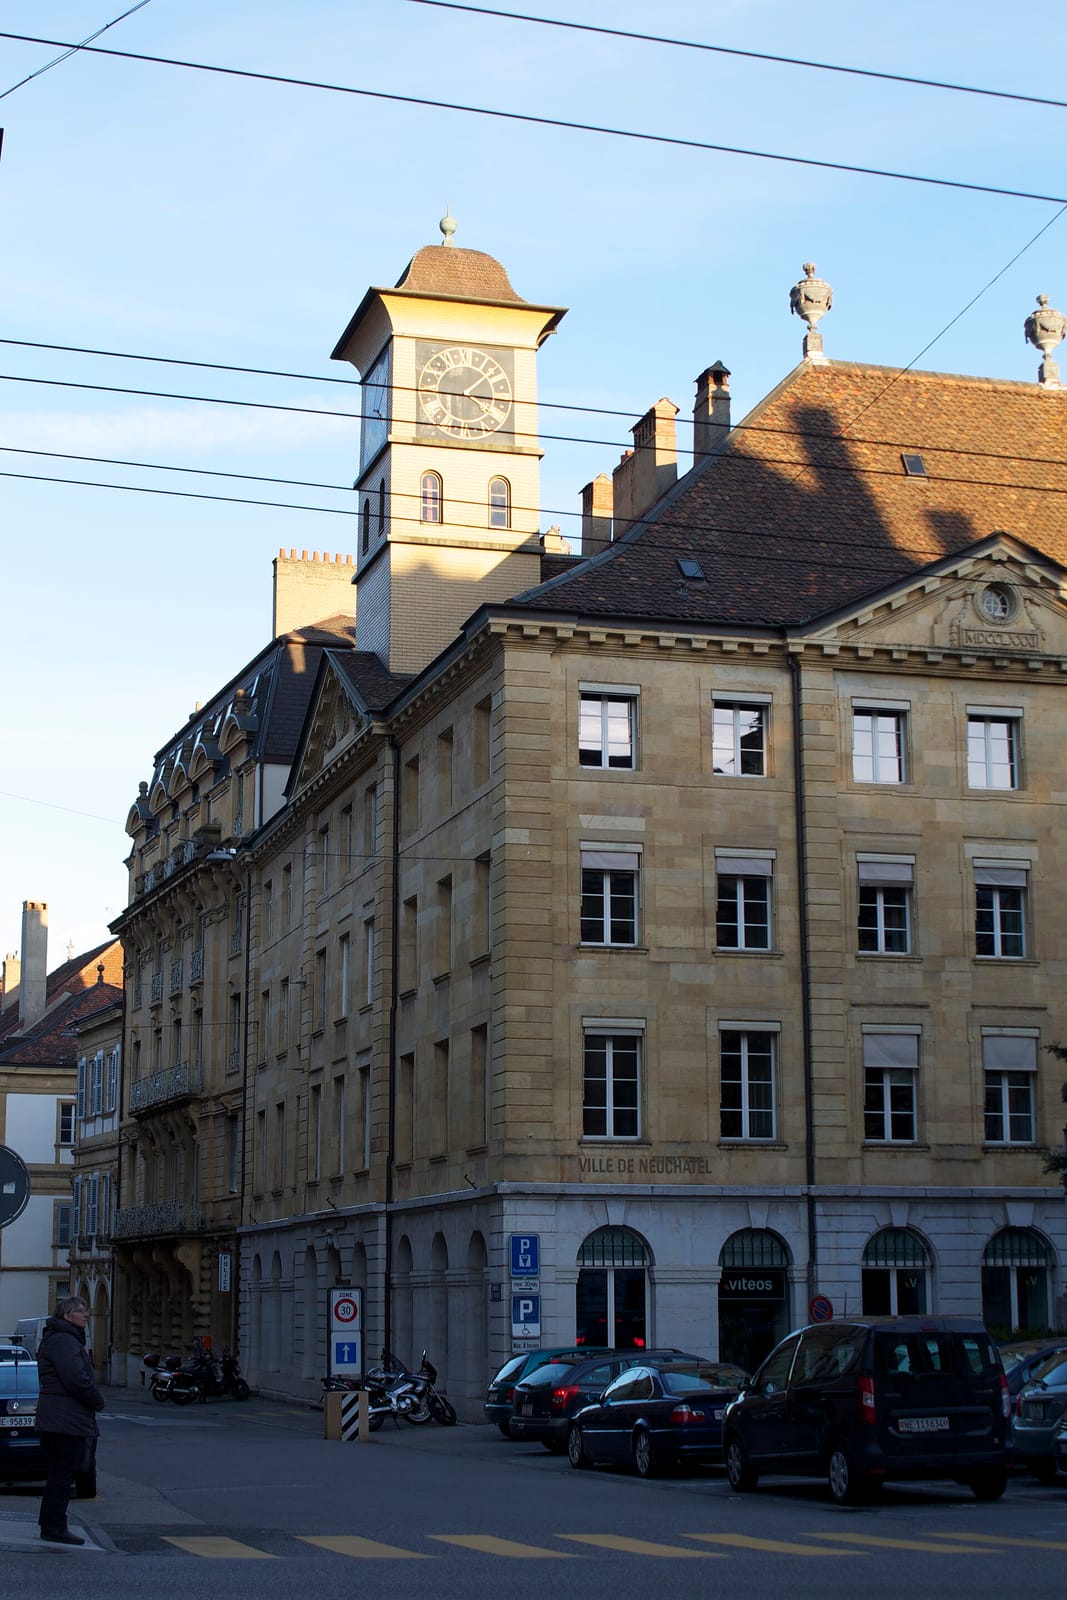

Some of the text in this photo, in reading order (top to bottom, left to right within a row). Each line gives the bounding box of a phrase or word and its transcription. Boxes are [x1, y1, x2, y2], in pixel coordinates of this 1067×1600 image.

[578, 1158, 712, 1174] VILLE DE NEUCHATEL
[520, 1239, 530, 1254] P
[728, 1277, 773, 1291] viteos
[340, 1305, 351, 1316] 30
[519, 1299, 533, 1321] P
